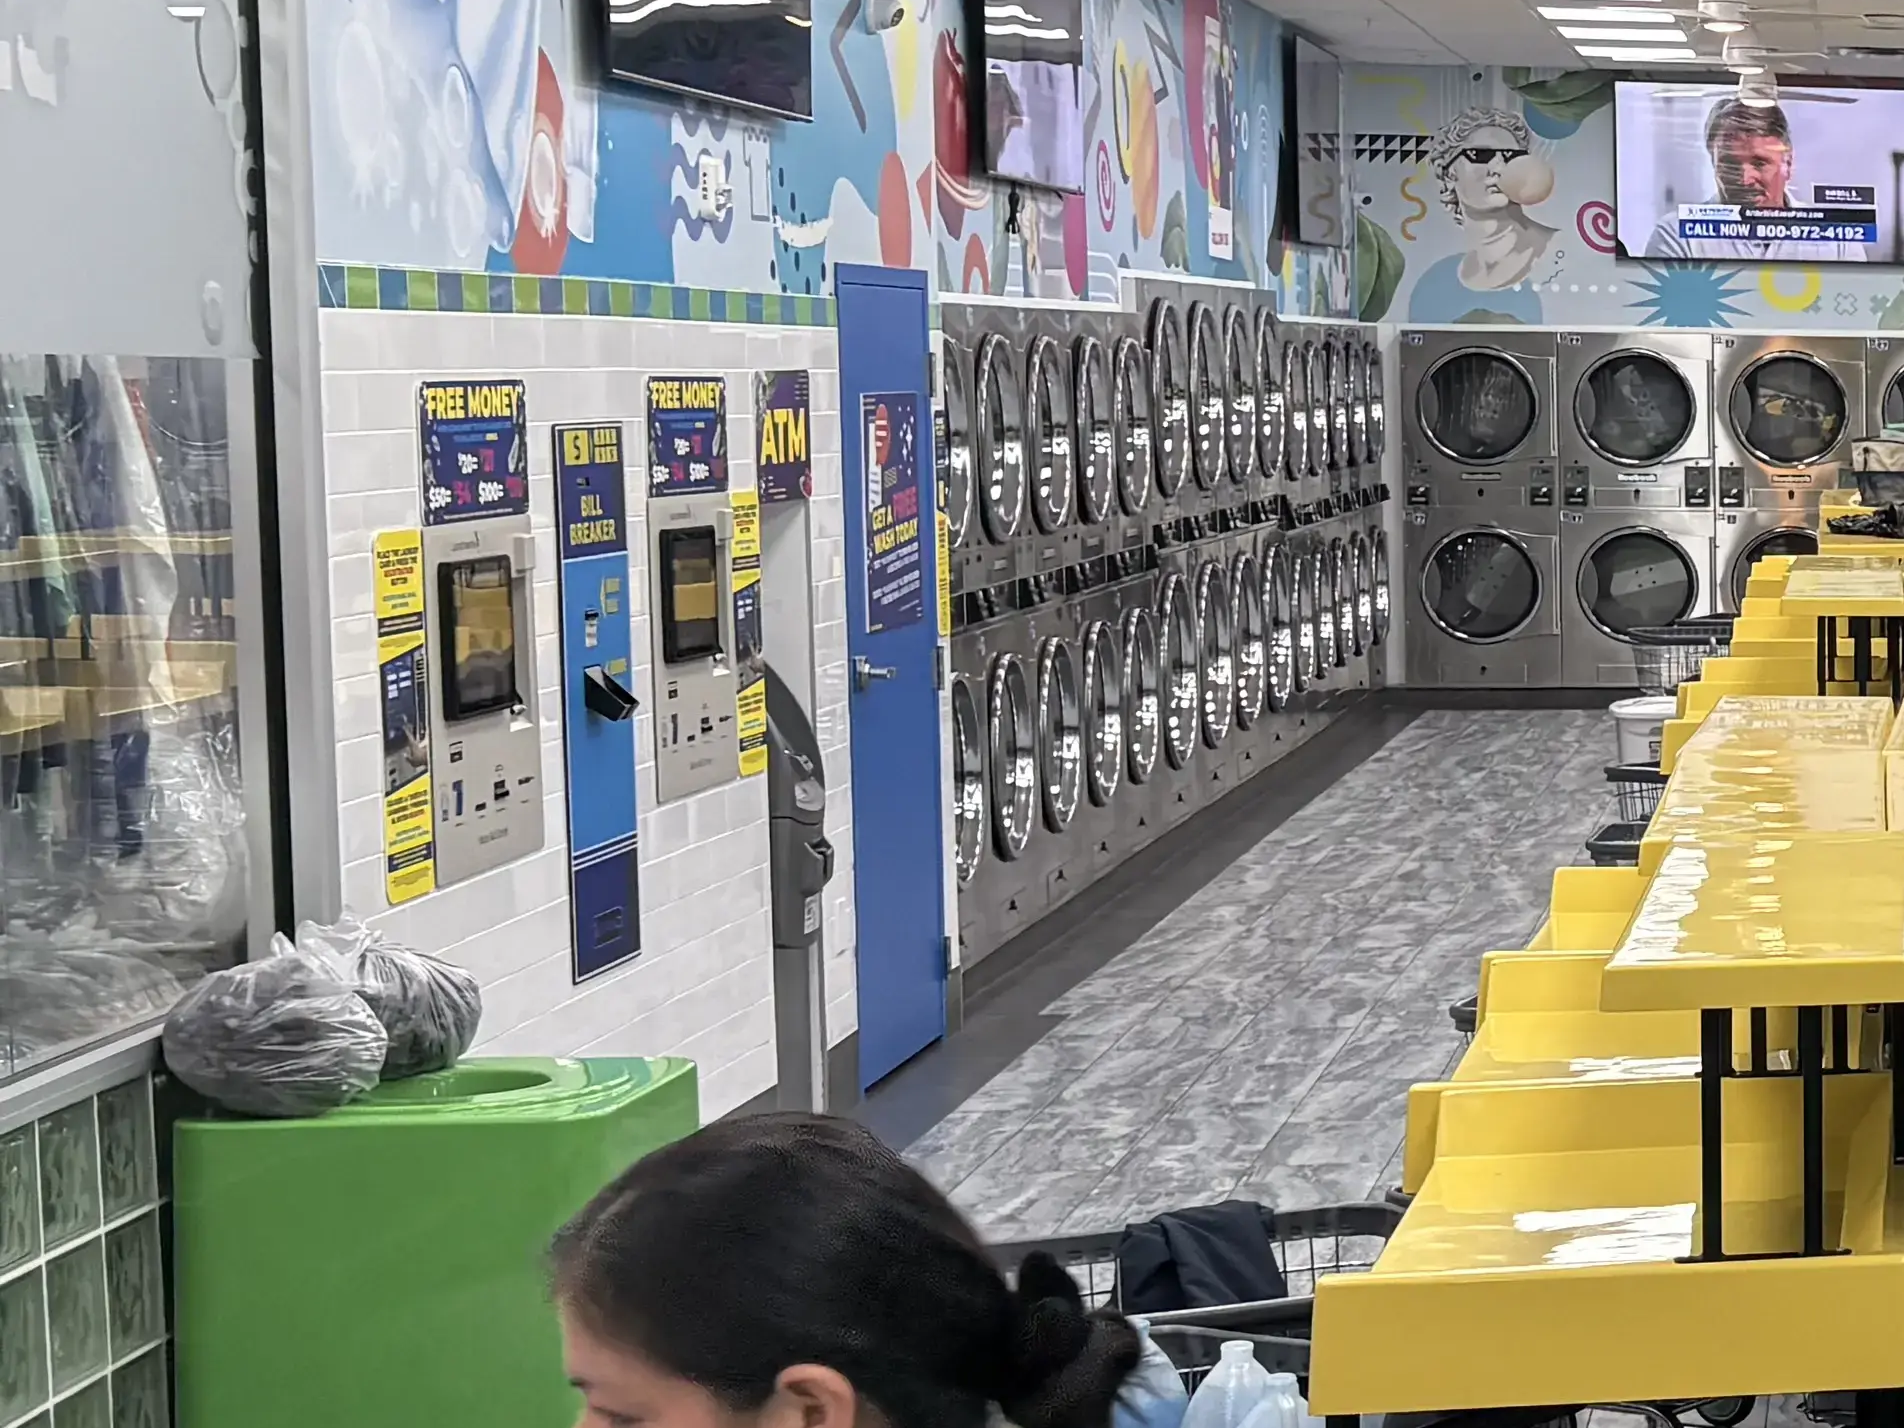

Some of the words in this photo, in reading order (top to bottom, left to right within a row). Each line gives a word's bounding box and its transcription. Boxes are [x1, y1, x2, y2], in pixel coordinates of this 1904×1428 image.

[1684, 224, 1716, 236] CALL
[1720, 224, 1750, 237] NOW
[1756, 225, 1865, 239] 800-972-4192
[426, 387, 465, 420] FREE
[467, 385, 519, 423] MONEY
[651, 381, 680, 409] FREE
[682, 381, 720, 413] MONEY
[760, 408, 806, 466] ATM
